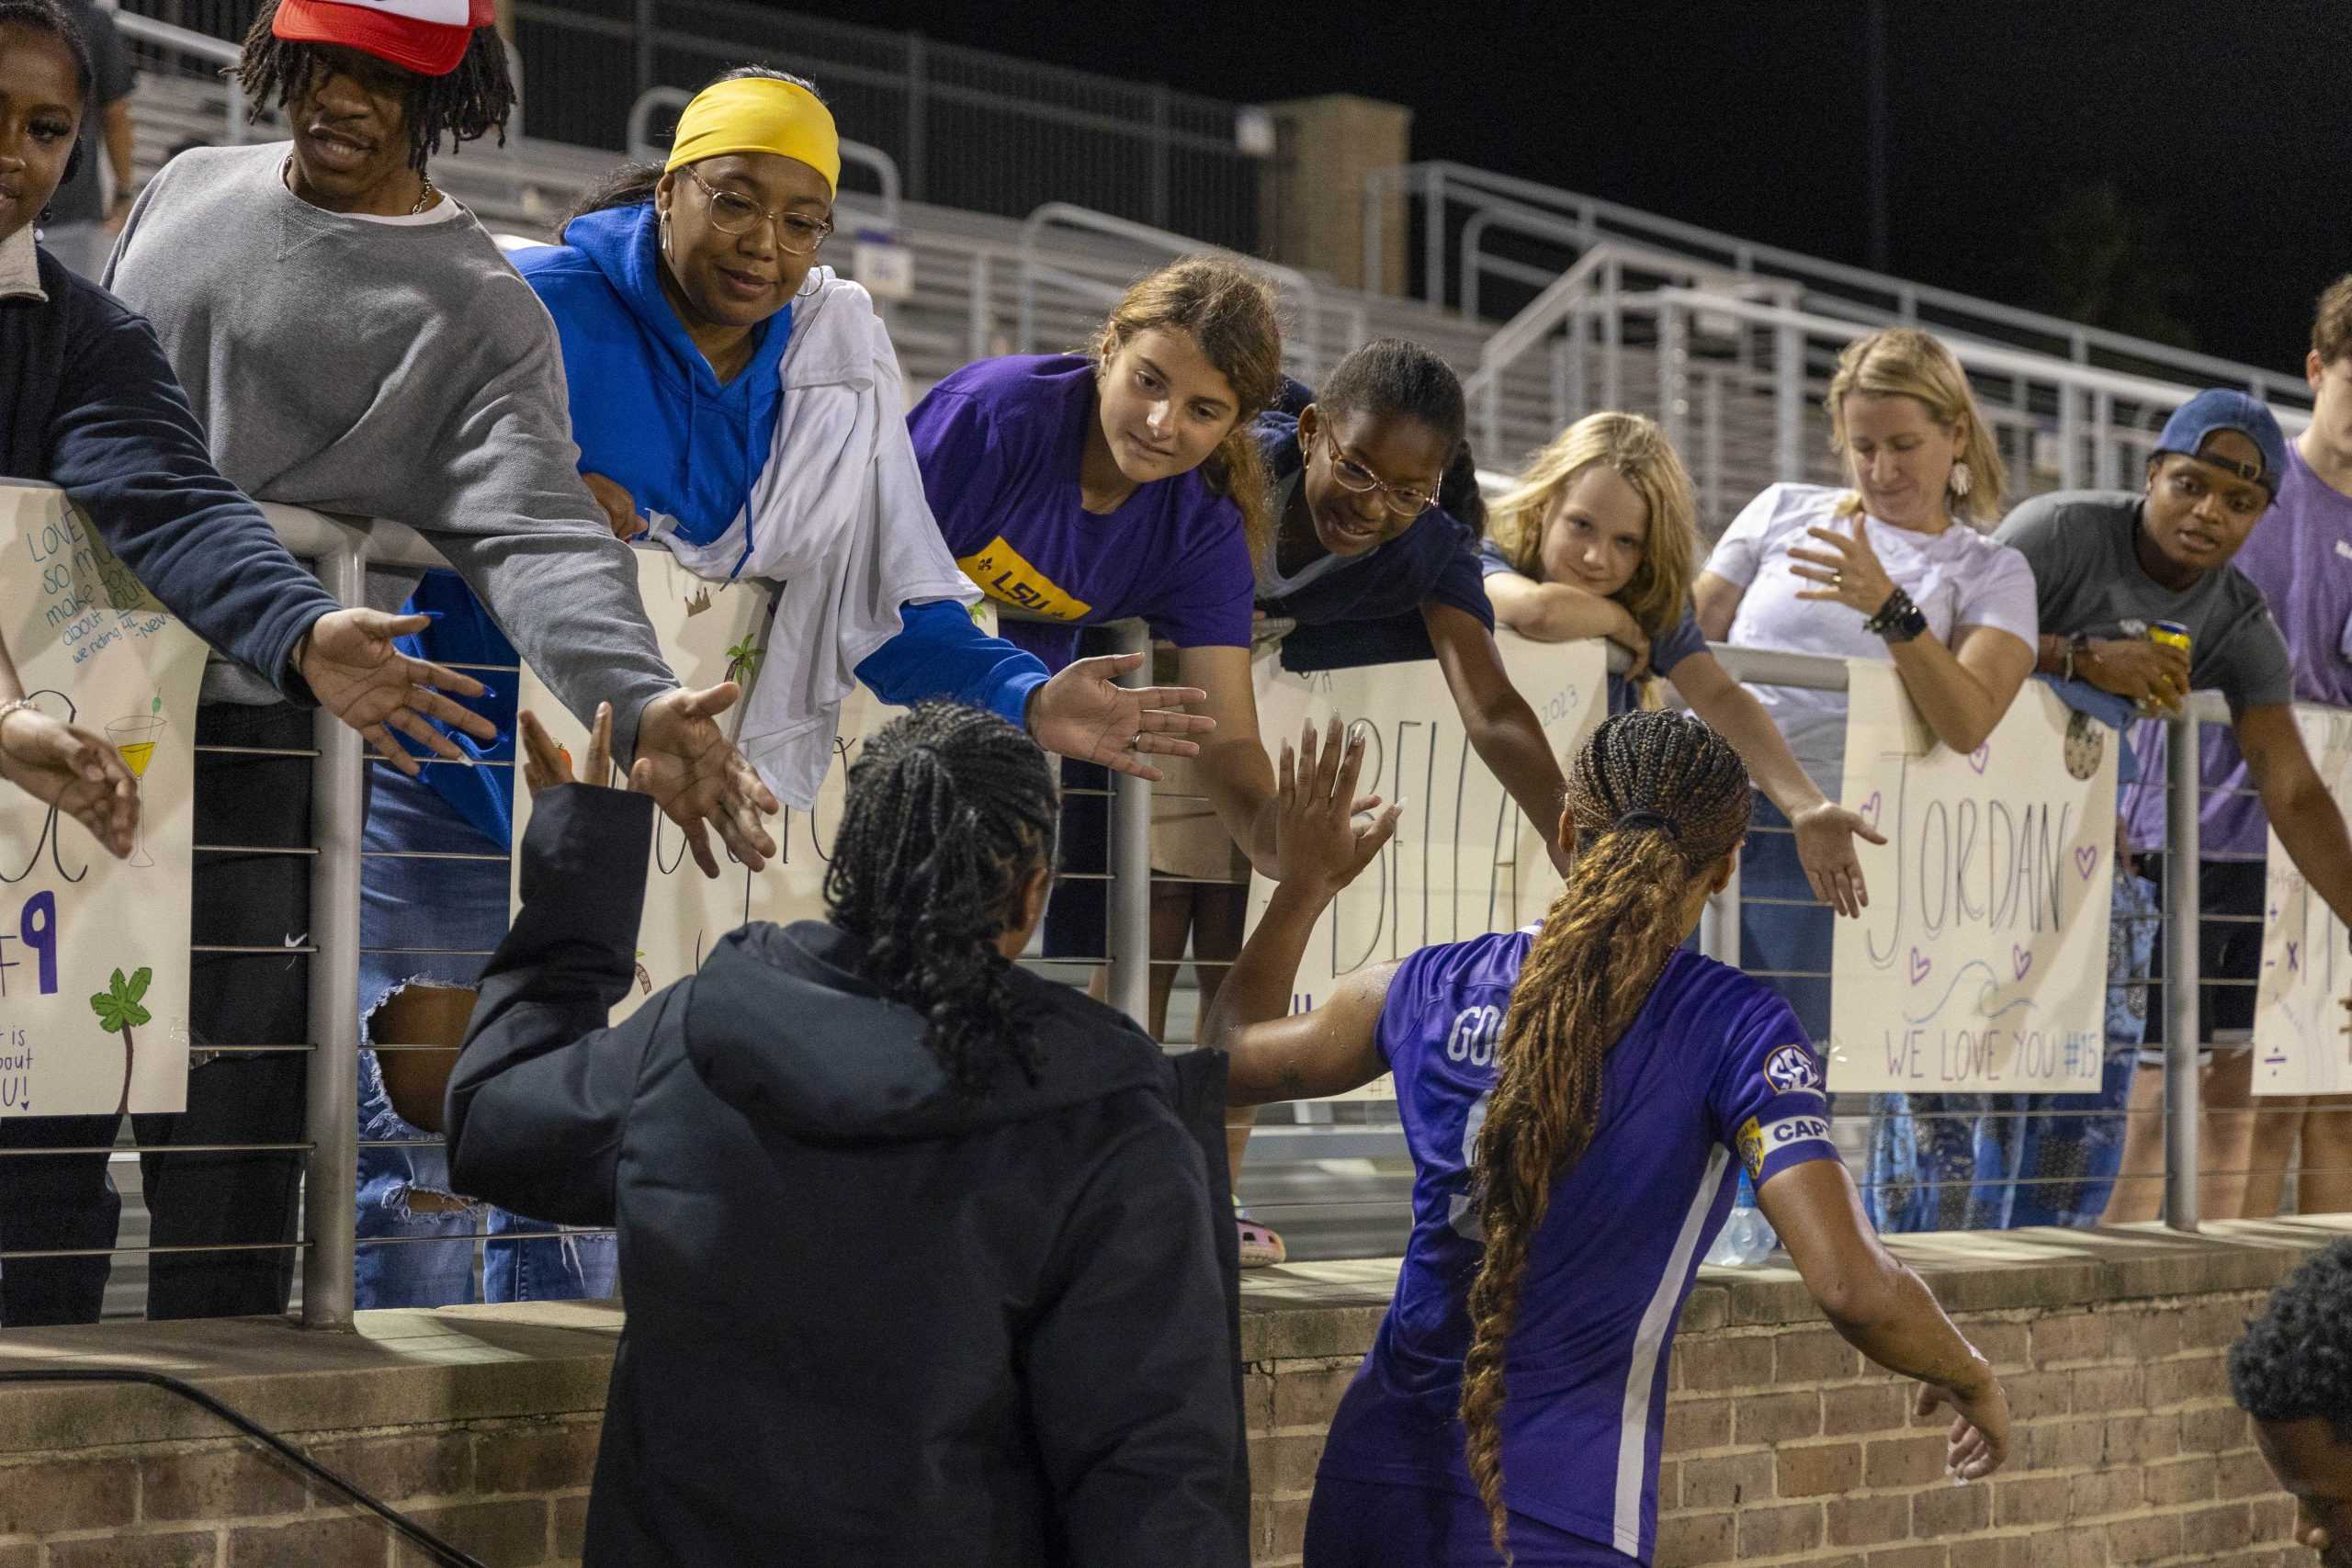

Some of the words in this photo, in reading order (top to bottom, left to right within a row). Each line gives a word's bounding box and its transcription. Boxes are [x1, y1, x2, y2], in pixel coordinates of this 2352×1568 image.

[27, 509, 85, 563] LOVE
[991, 570, 1052, 611] LSU
[1867, 750, 2072, 970] JORDAN
[1447, 1004, 1507, 1068] GO
[1885, 1030, 1925, 1078] WE
[1940, 1030, 2000, 1081] LOVE
[2013, 1031, 2056, 1078] YOU
[2064, 1032, 2099, 1079] #15
